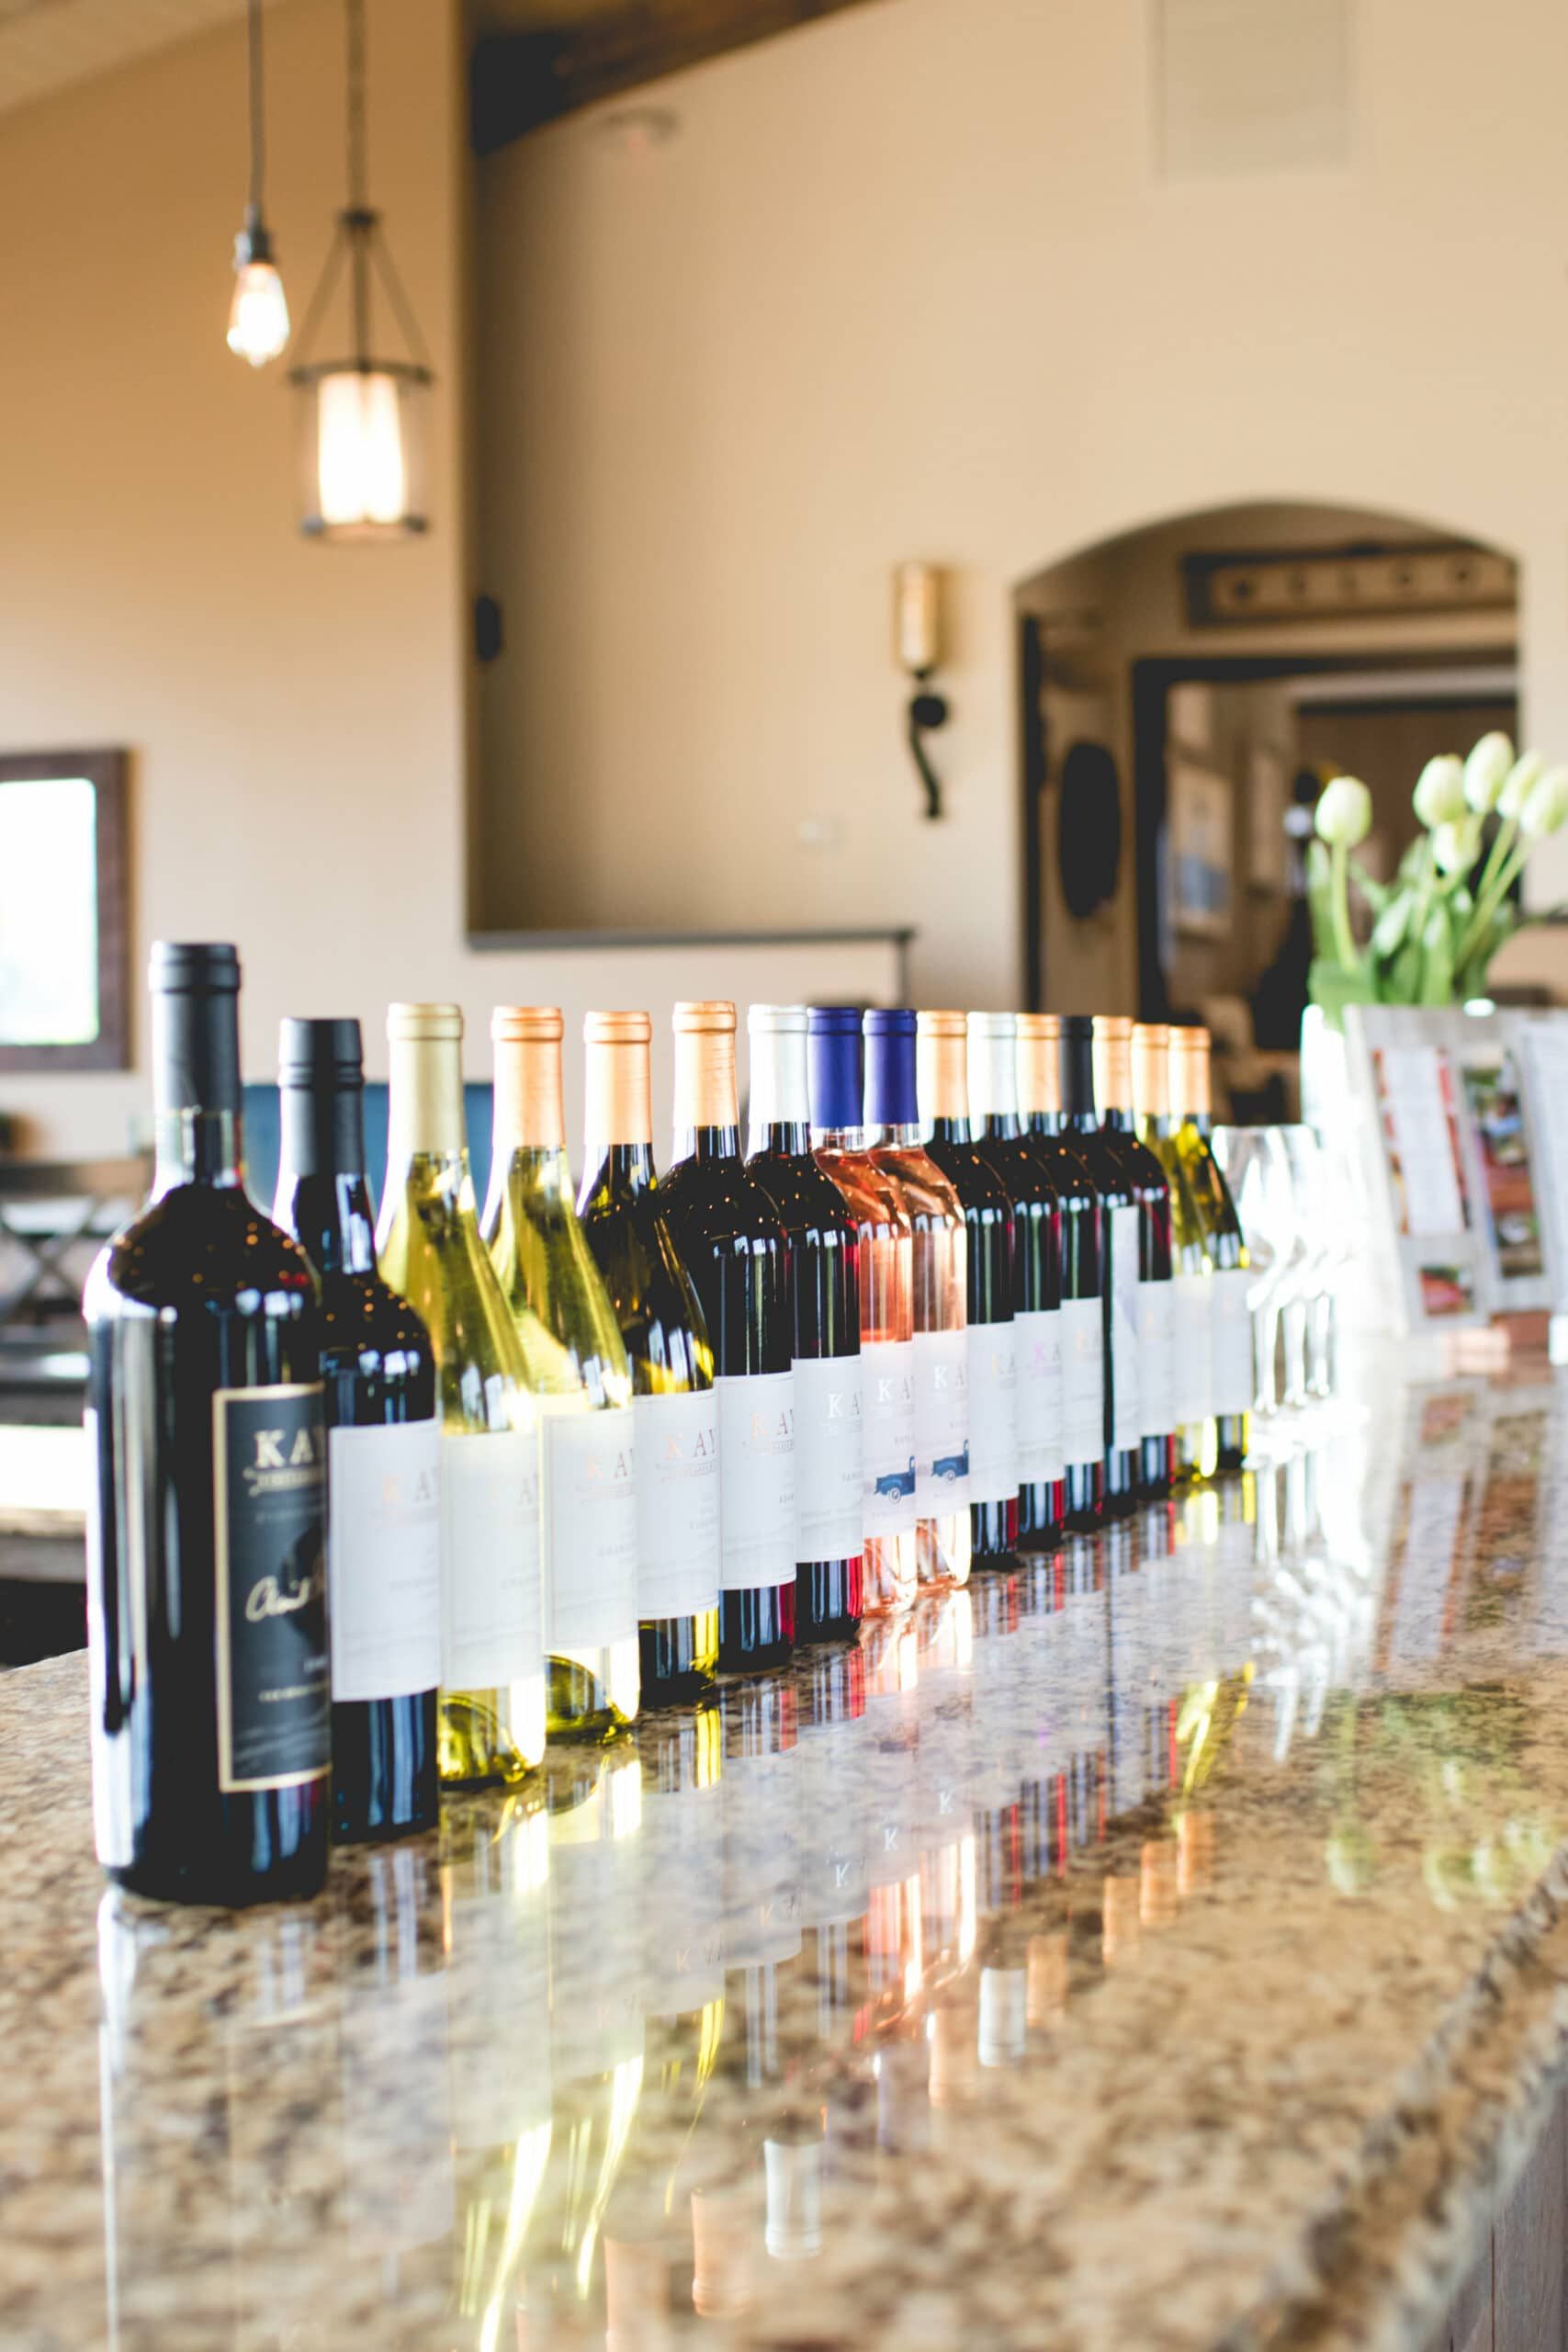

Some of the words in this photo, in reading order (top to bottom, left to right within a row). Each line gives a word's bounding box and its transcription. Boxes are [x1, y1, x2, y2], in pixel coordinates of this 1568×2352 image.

[878, 1374, 915, 1402] KA
[828, 1390, 863, 1419] KA
[587, 1448, 633, 1480] KA
